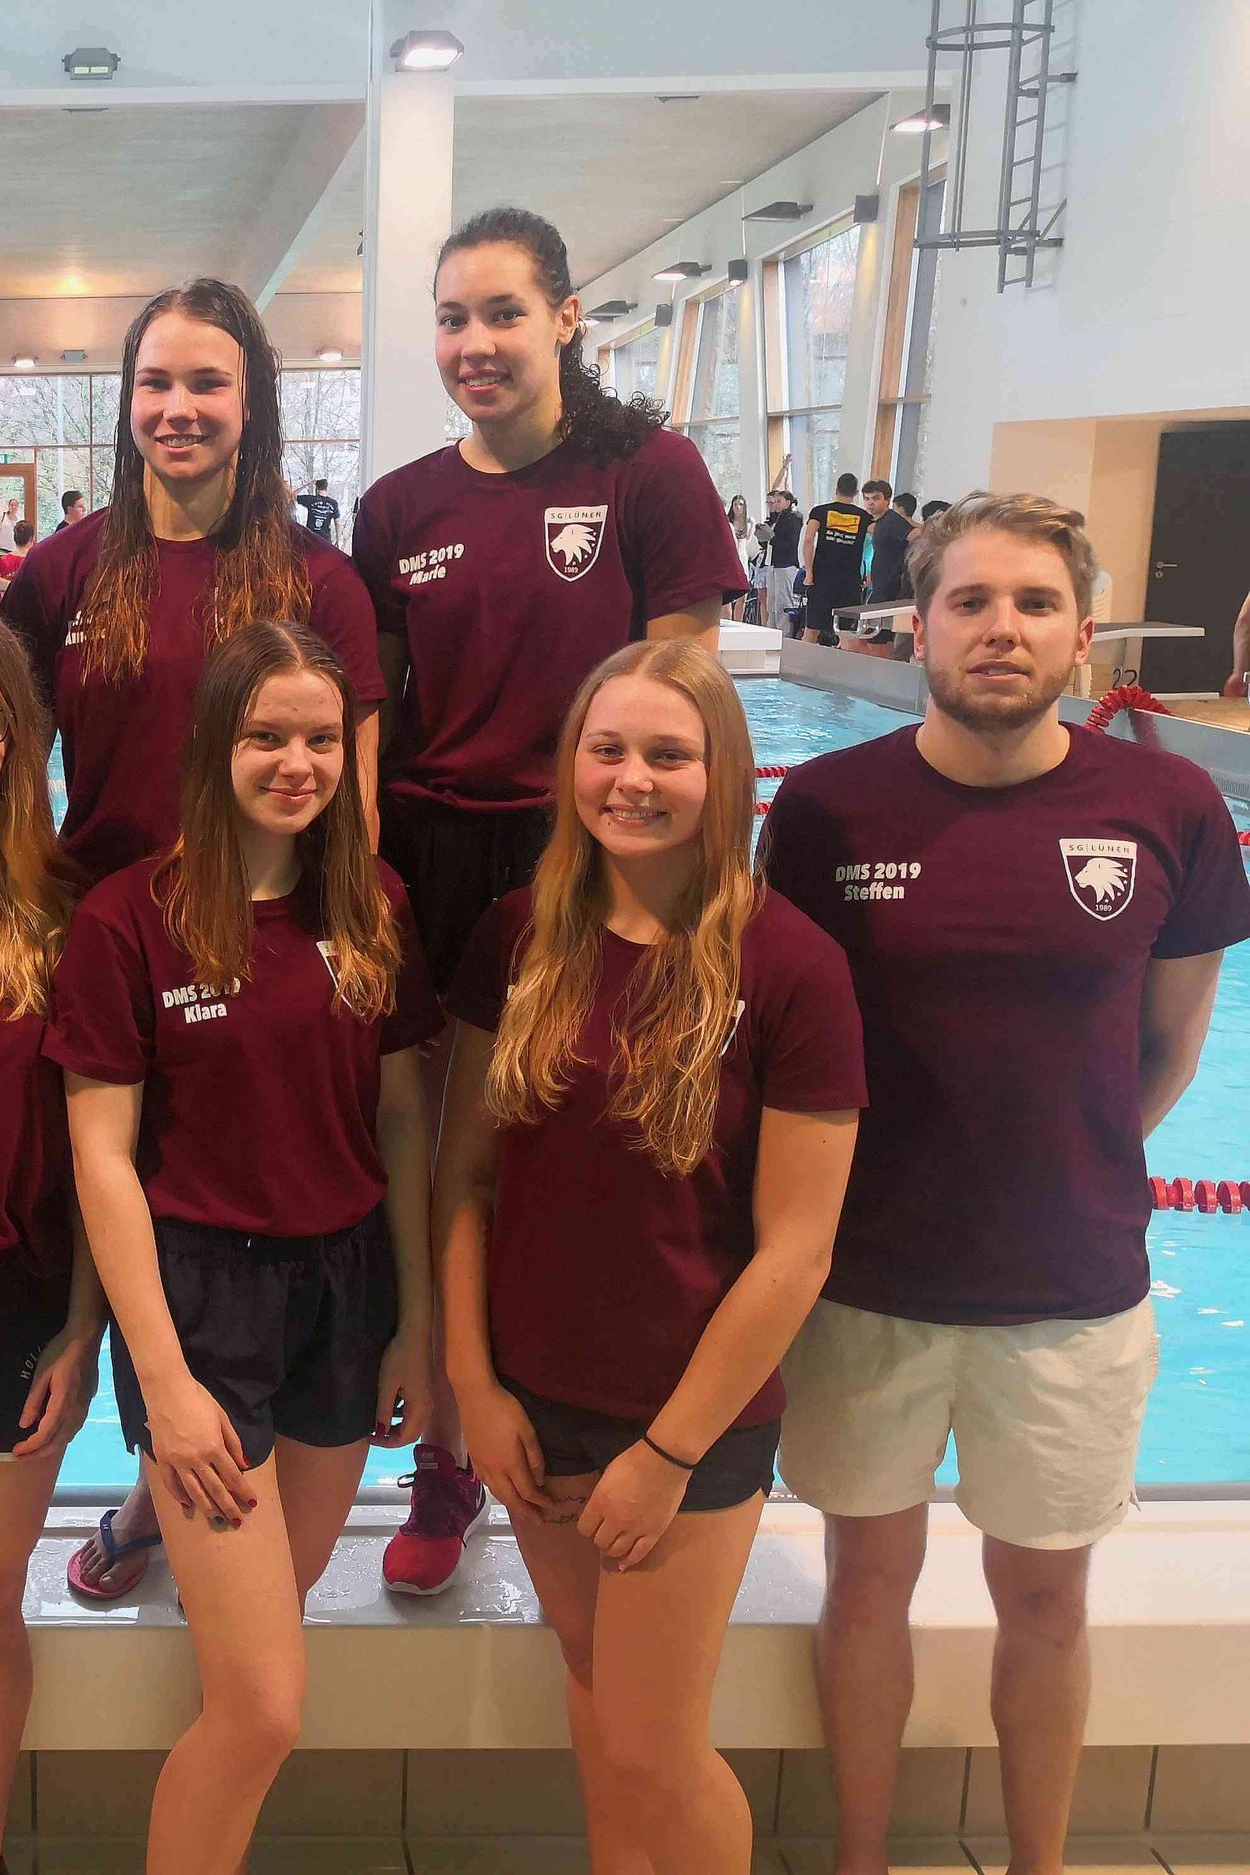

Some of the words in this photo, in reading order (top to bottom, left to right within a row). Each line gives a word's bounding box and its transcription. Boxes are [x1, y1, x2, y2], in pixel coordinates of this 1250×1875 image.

[399, 552, 427, 574] DMS
[429, 543, 465, 565] 2019
[409, 564, 447, 585] Marie
[1069, 844, 1084, 852] SG
[1091, 843, 1130, 854] LÜNEN
[835, 863, 871, 882] DMS
[873, 862, 922, 880] 2019
[844, 881, 905, 901] Steffen
[162, 984, 198, 1009] DMS
[184, 1003, 227, 1024] Klara
